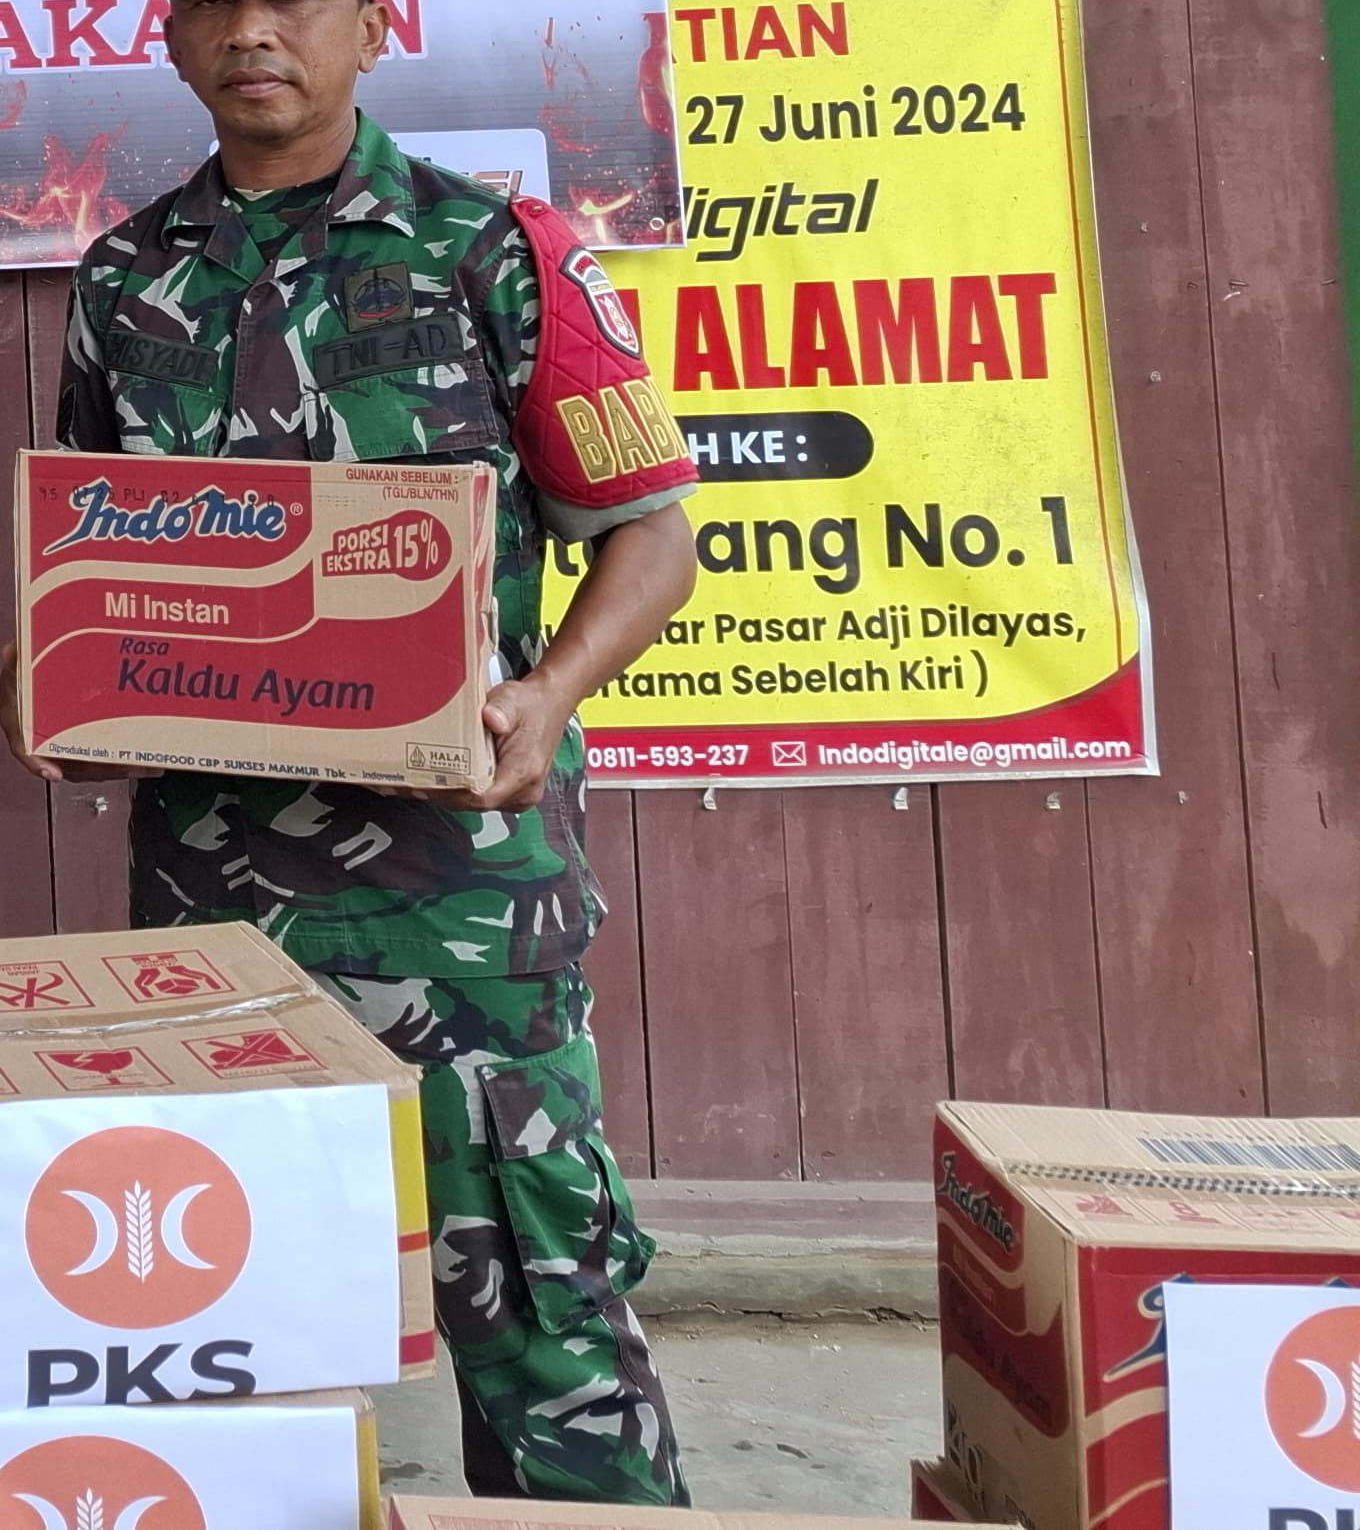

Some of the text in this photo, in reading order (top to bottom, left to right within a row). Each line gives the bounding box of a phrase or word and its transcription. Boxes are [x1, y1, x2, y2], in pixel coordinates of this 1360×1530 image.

[672, 1, 850, 64] TIAN
[685, 82, 1026, 145] 27 Juni 2024
[673, 272, 1057, 392] ALAMAT
[731, 430, 786, 465] KE
[345, 468, 398, 482] GUNAKAN
[400, 470, 452, 485] SEBELUM
[382, 485, 459, 504] (TGL/BLN/THN)
[337, 518, 439, 570] PORSI 15%
[884, 502, 1026, 570] No.
[1040, 495, 1074, 566] 1
[326, 547, 392, 573] EKSTRA
[104, 591, 230, 625] Mi Instan
[714, 613, 827, 644] Pasar
[837, 604, 911, 650] Adji
[920, 603, 1087, 649] Dilayas,
[119, 636, 171, 656] Rasa
[117, 657, 375, 717] Kaldu Ayam
[731, 659, 890, 695] Sebelah
[899, 654, 965, 691] Kiri
[118, 750, 132, 760] PT
[134, 751, 196, 767] INDOFOOD
[198, 757, 220, 769] CBP
[223, 759, 266, 772] SUKSES
[268, 762, 320, 777] MAKMUR
[324, 767, 346, 780] Tbk
[429, 750, 468, 763] HALAL
[586, 736, 1132, 770] 0811-593-237 Indodigitale@gmail.com
[26, 1339, 257, 1409] PKS
